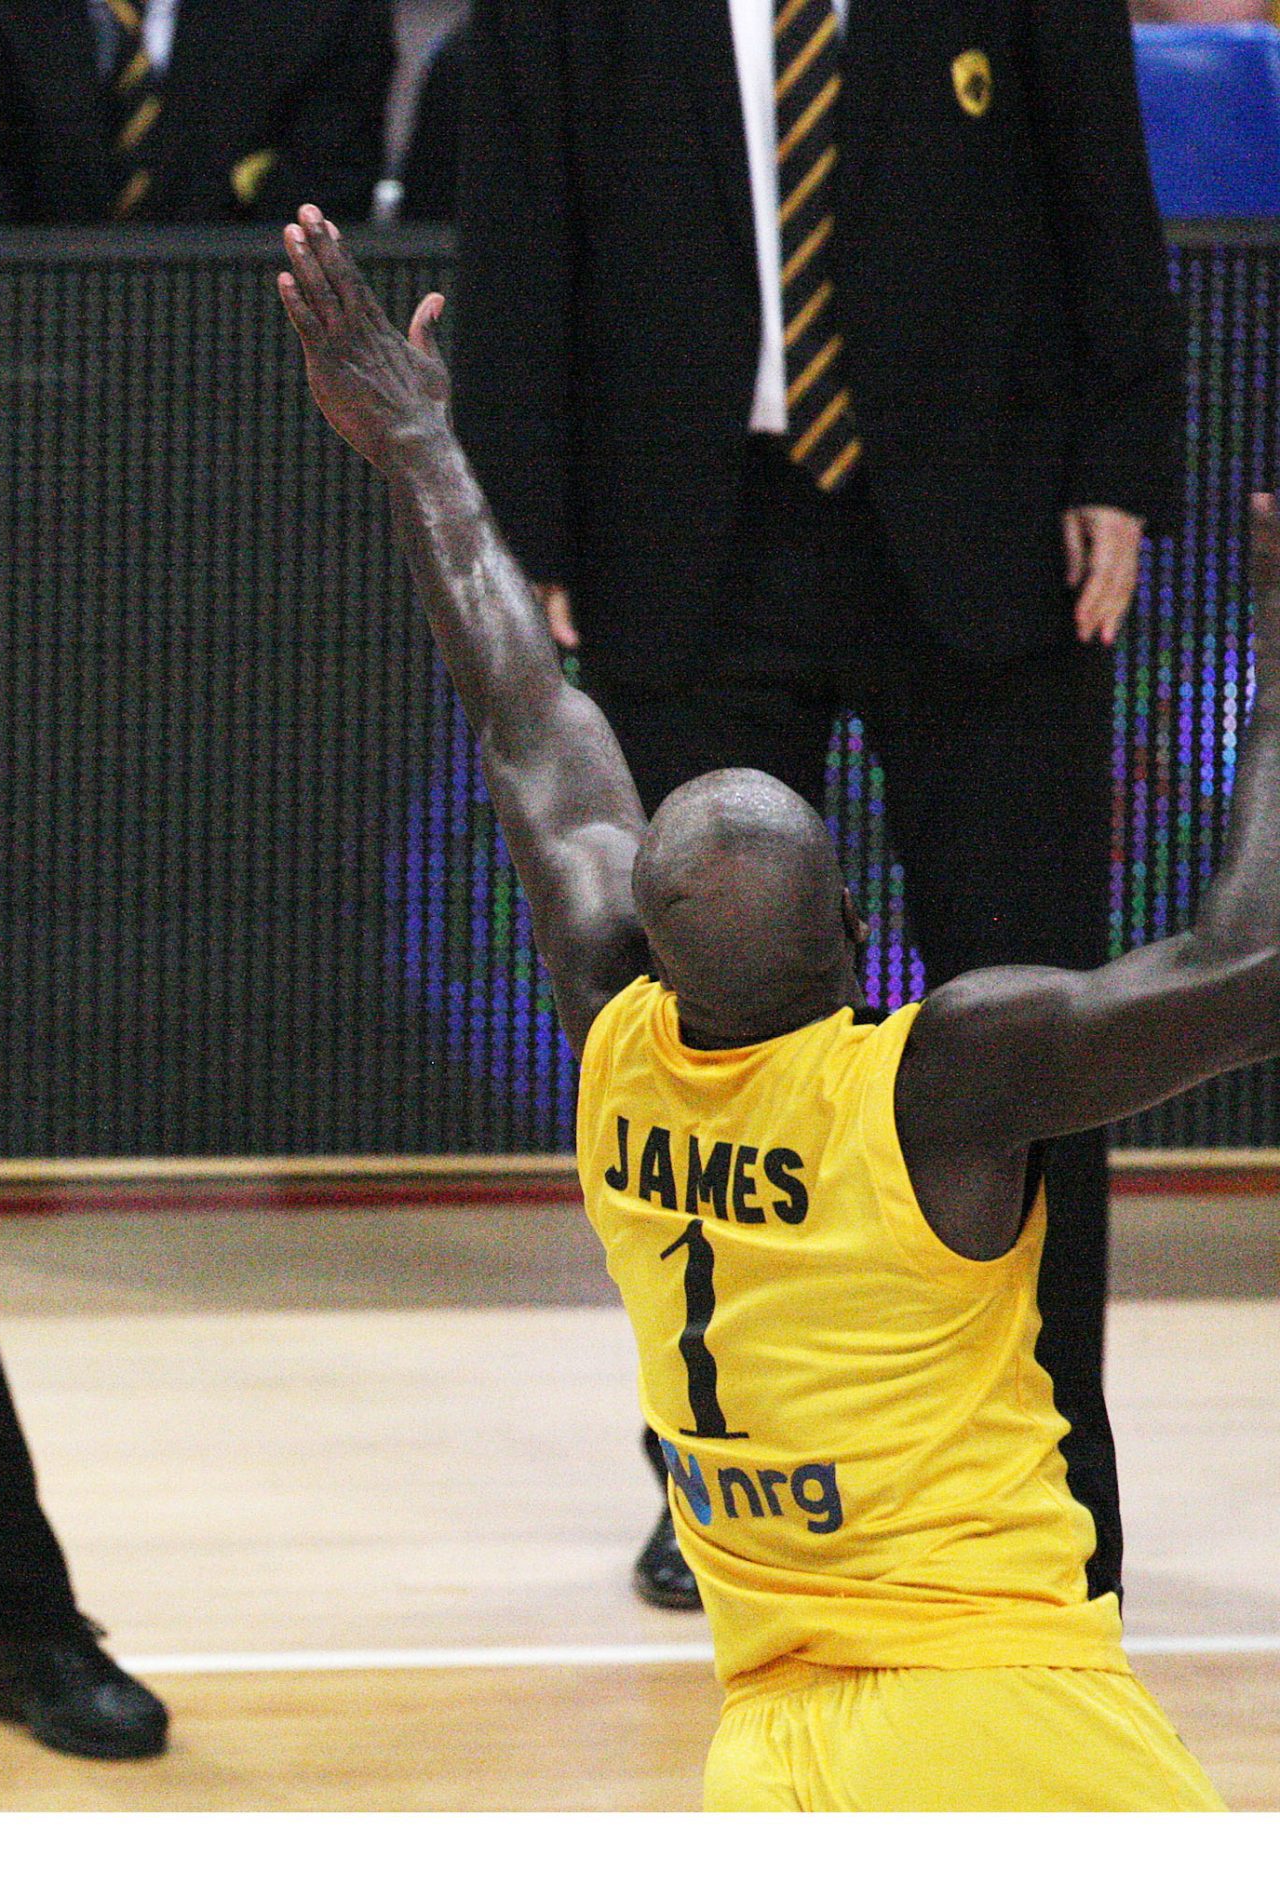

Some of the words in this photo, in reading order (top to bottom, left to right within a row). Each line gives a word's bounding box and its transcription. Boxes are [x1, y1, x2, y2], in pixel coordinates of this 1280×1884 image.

[604, 1115, 809, 1225] JAMES
[660, 1218, 749, 1439] 1
[717, 1461, 844, 1535] nrg
